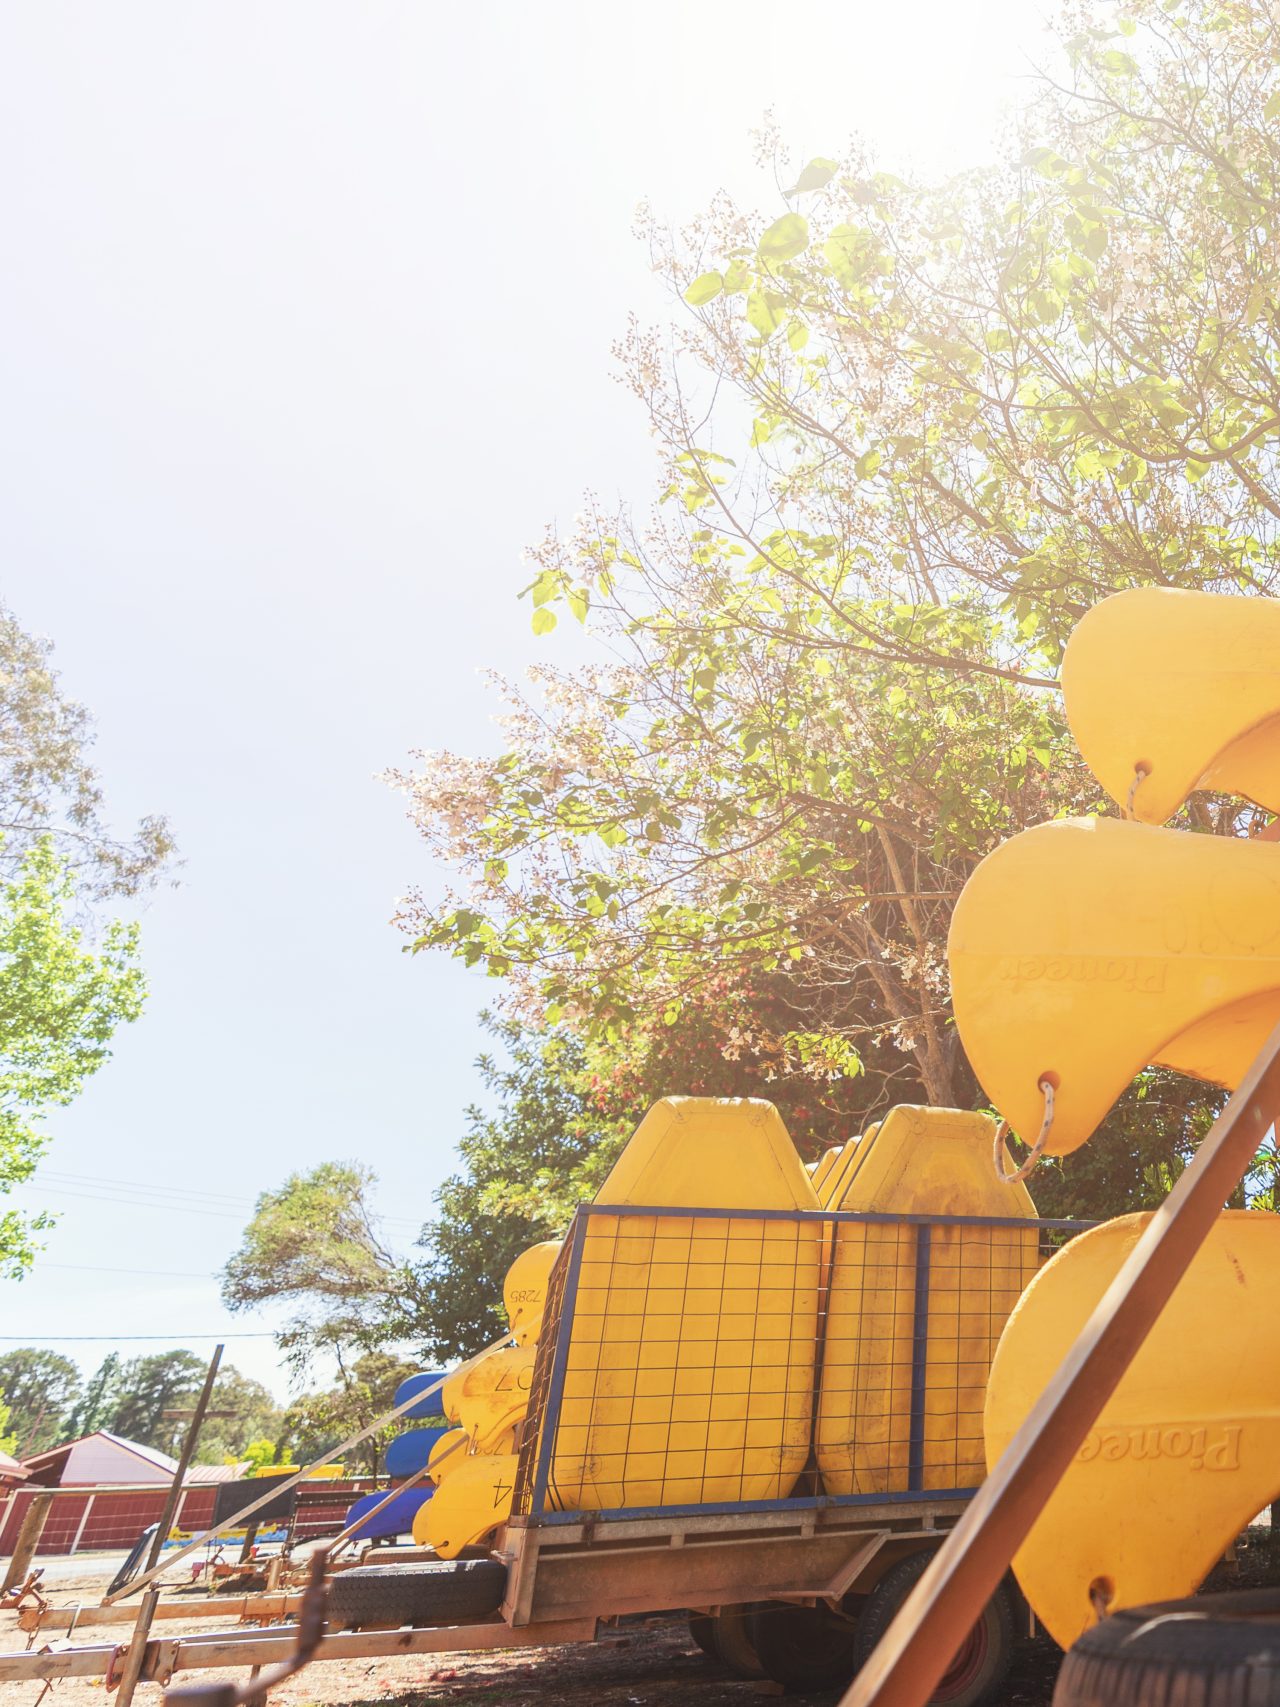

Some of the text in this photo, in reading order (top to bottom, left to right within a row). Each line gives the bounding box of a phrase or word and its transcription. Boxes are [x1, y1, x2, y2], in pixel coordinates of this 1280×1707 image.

[510, 1289, 541, 1304] 7285
[1073, 1424, 1243, 1473] Pionee
[493, 1477, 513, 1509] 4
